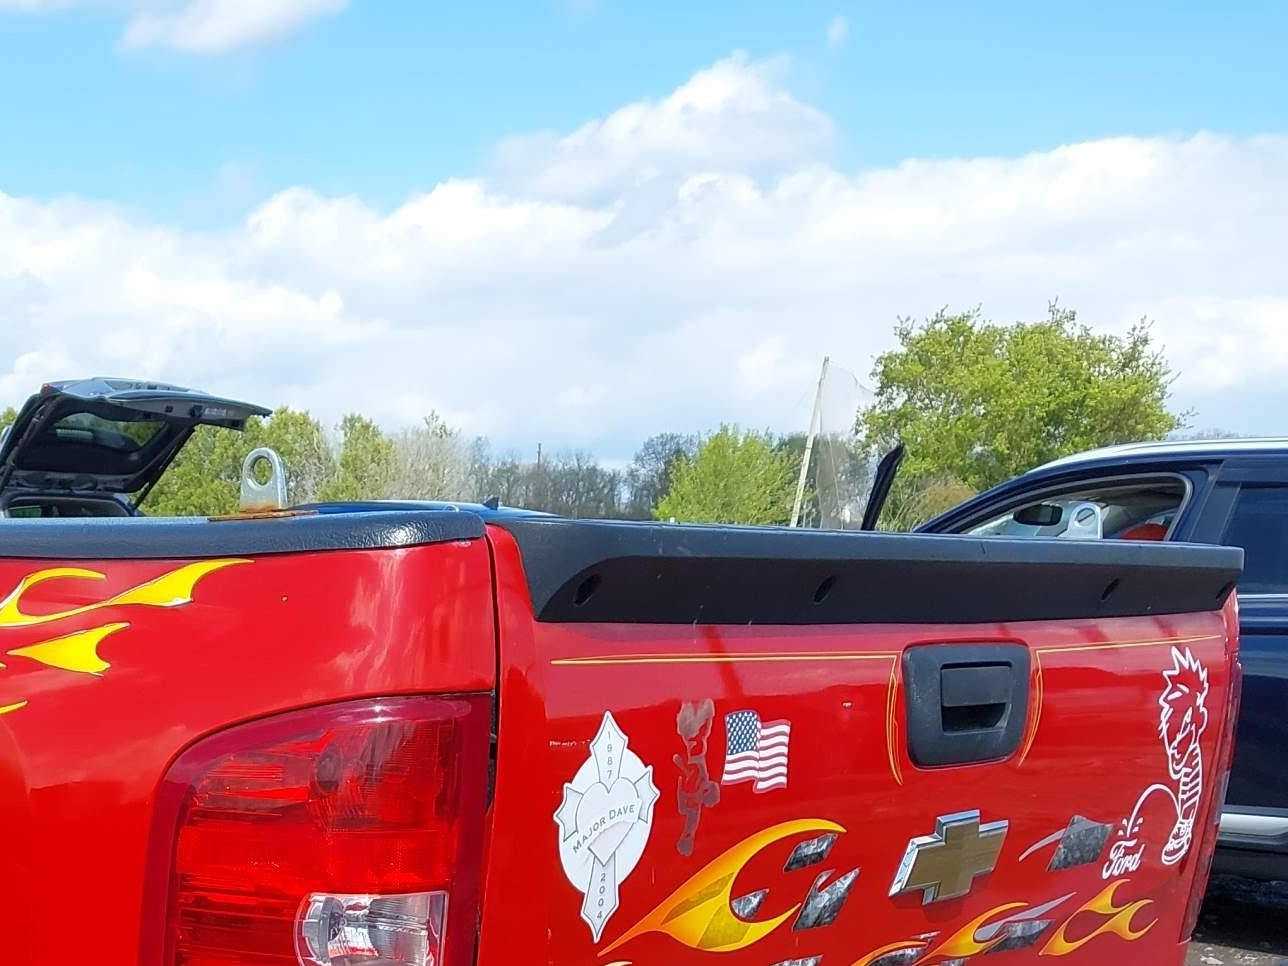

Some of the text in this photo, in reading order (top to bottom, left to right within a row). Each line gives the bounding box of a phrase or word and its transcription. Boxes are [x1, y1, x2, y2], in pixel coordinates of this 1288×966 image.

[572, 804, 636, 854] MAJOR DAVE
[1102, 840, 1145, 880] Ford
[596, 873, 606, 920] 2004
